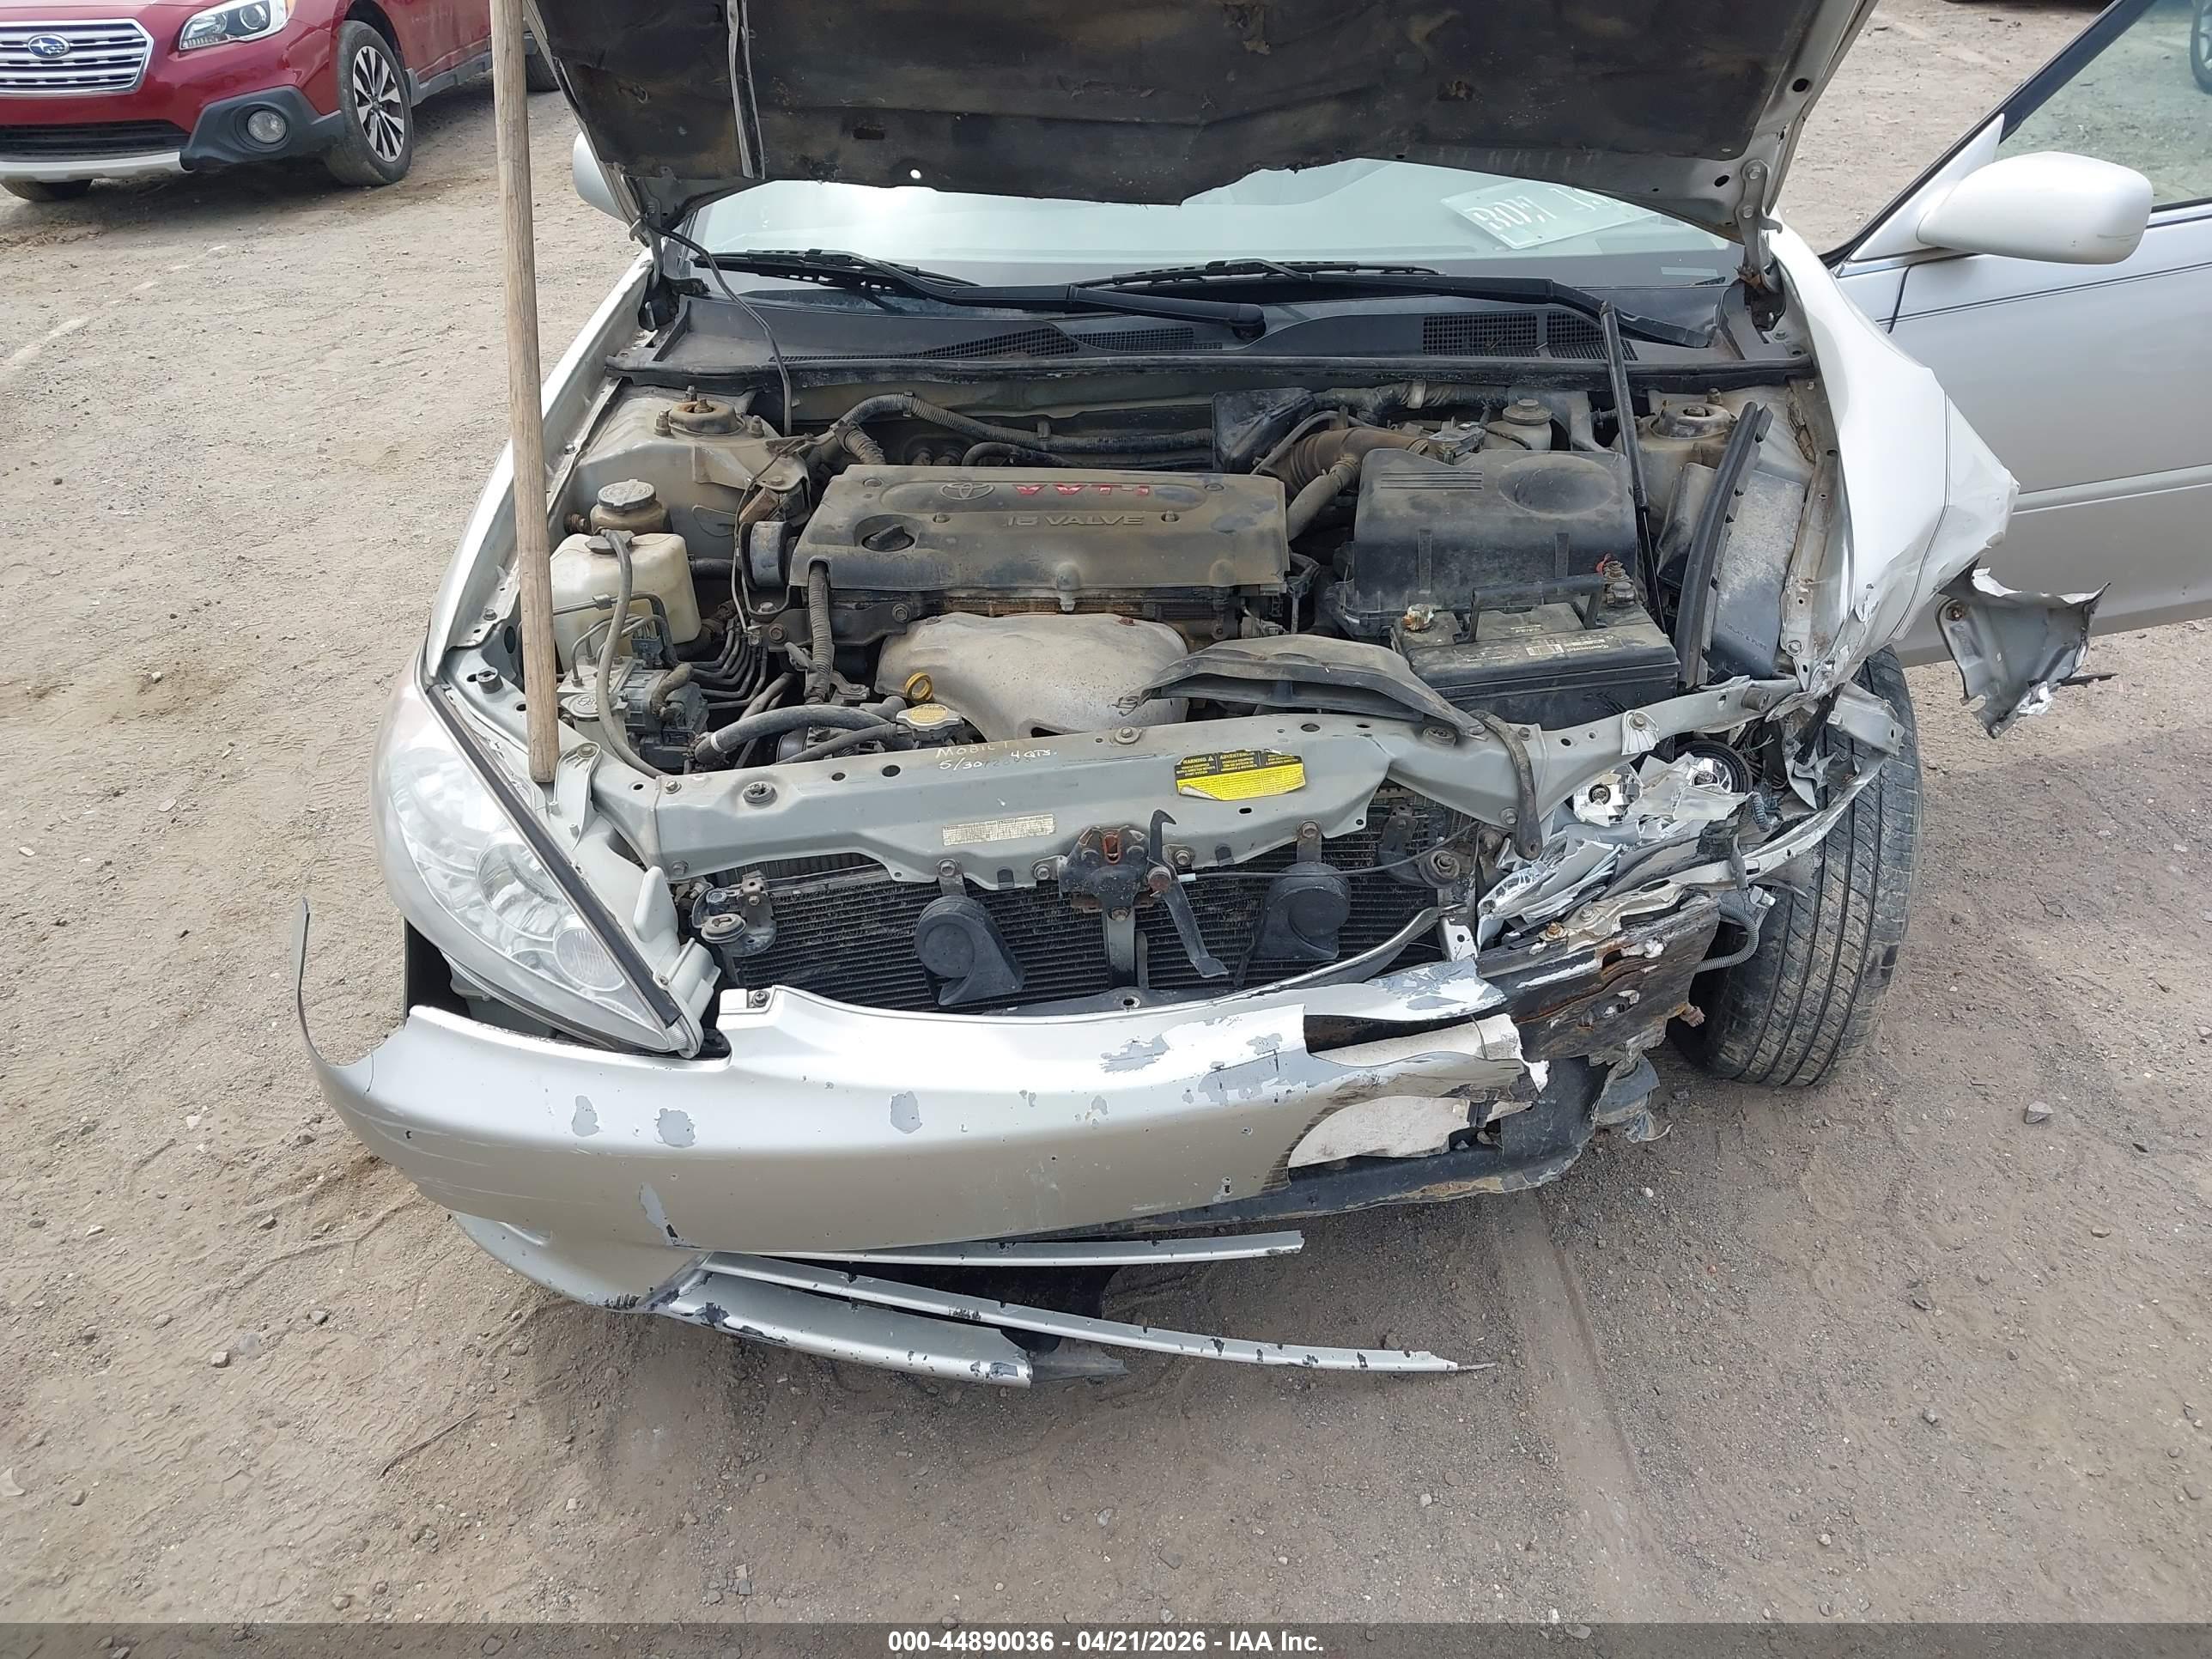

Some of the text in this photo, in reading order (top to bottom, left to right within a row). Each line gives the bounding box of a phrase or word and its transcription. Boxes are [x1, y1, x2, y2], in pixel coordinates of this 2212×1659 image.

[1006, 515, 1144, 526] 16 VALVE
[935, 744, 996, 758] MOBIL
[1011, 750, 1020, 759] 4
[939, 757, 982, 771] 5/30
